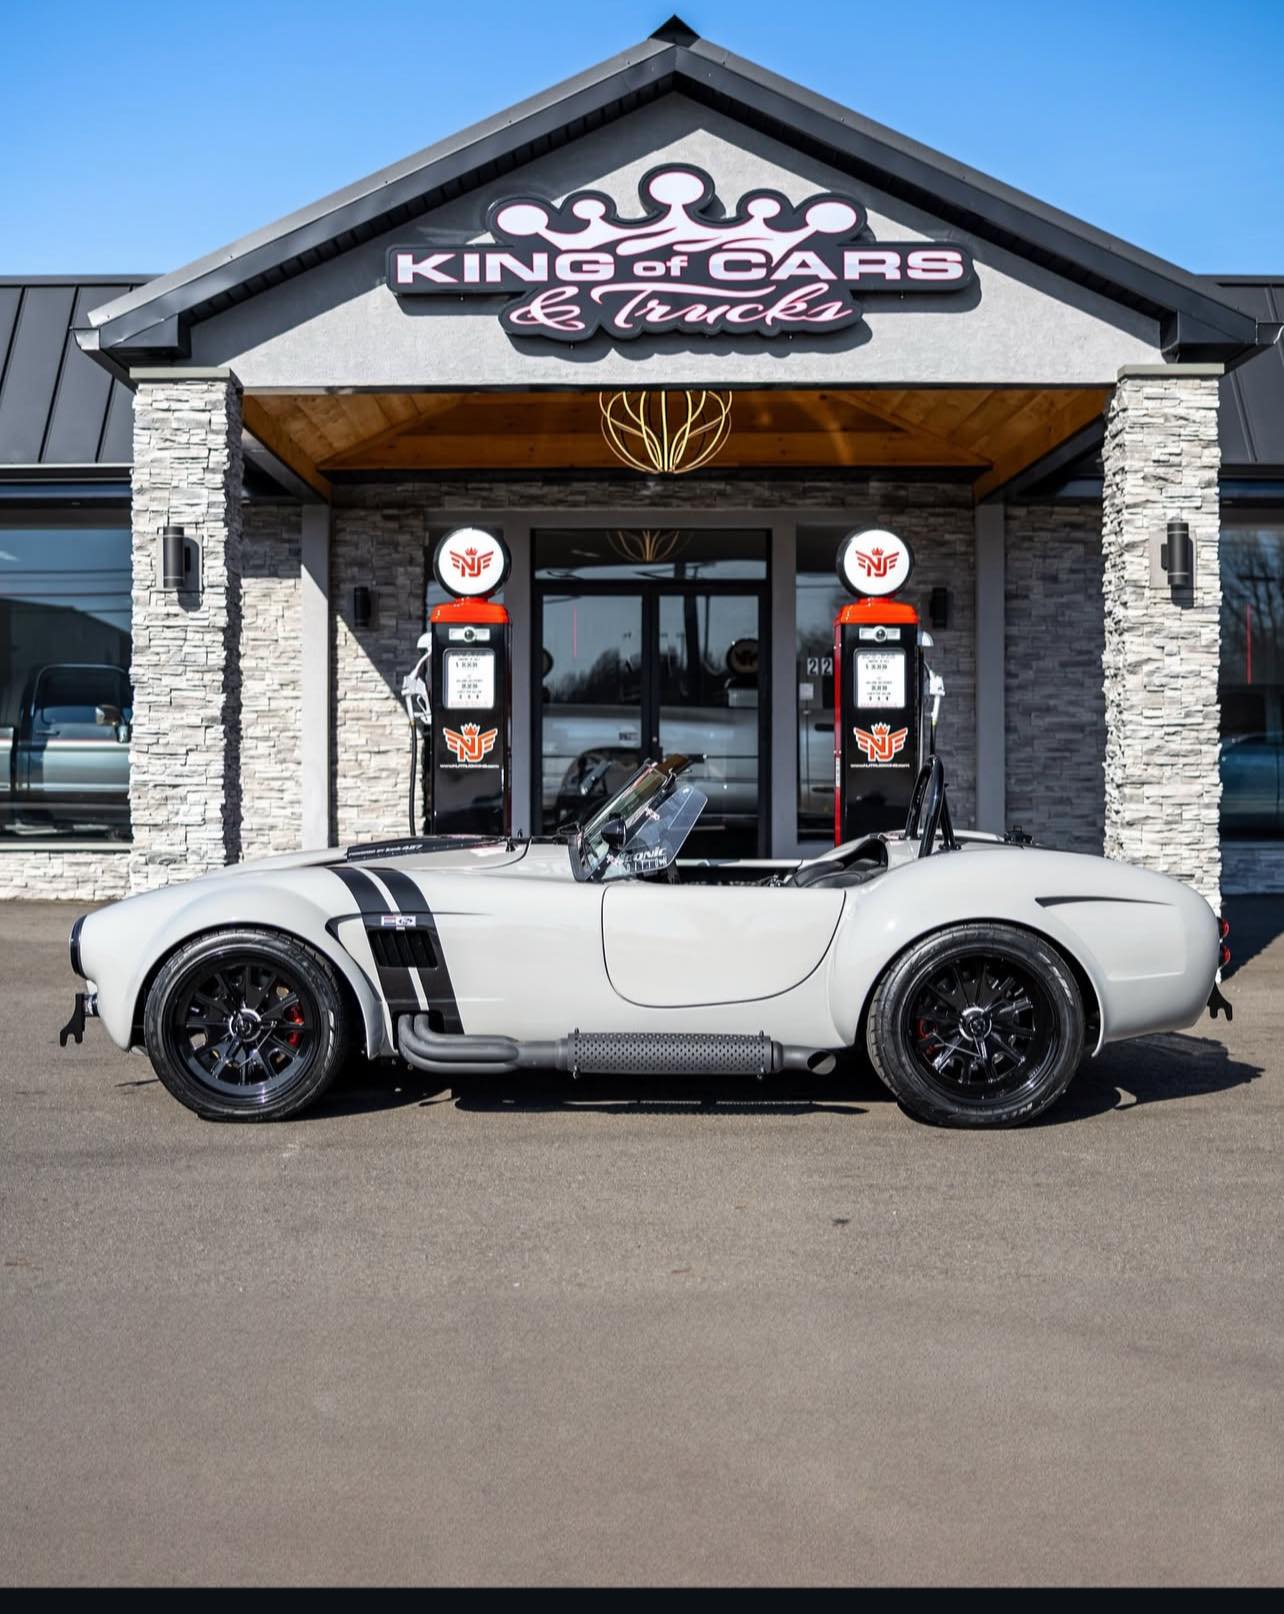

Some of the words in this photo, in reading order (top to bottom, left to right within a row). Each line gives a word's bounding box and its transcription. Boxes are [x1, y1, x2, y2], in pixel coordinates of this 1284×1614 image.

[396, 251, 615, 283] KING
[633, 256, 689, 278] of
[709, 250, 964, 281] CARS
[509, 286, 586, 330] &
[591, 283, 856, 328] Trucks
